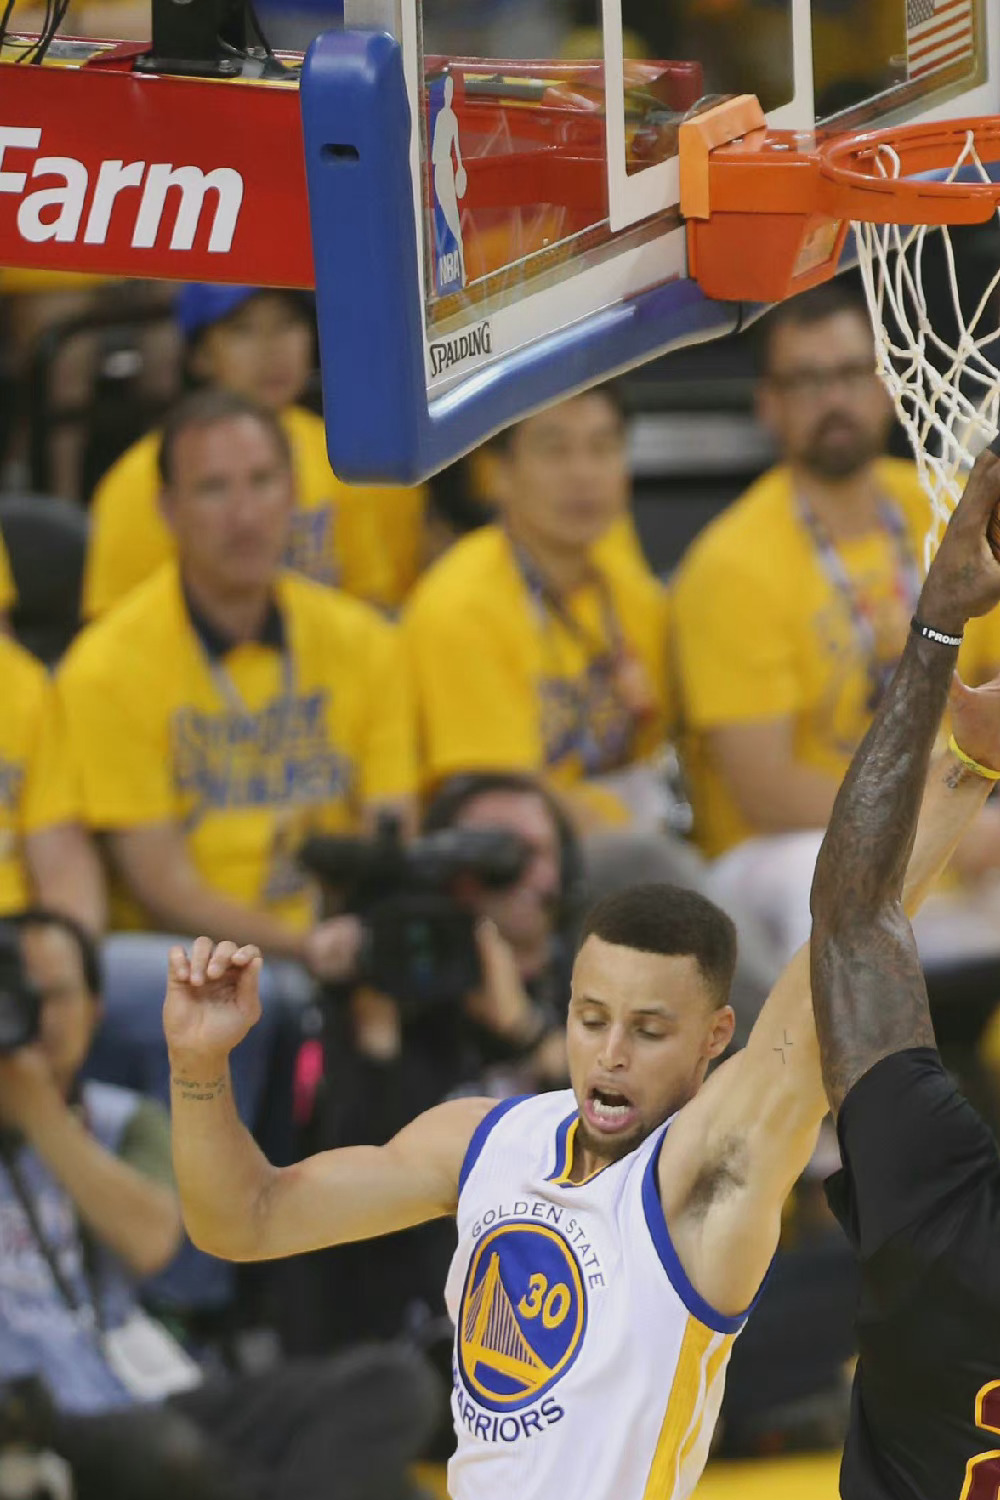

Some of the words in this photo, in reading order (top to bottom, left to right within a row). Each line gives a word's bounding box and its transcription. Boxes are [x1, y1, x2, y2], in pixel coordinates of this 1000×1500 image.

[0, 125, 244, 253] Farm
[439, 250, 461, 287] NBA
[430, 320, 492, 378] SPALDING
[471, 1201, 564, 1239] GOLDEN
[565, 1218, 607, 1290] STATE
[518, 1272, 572, 1329] 30
